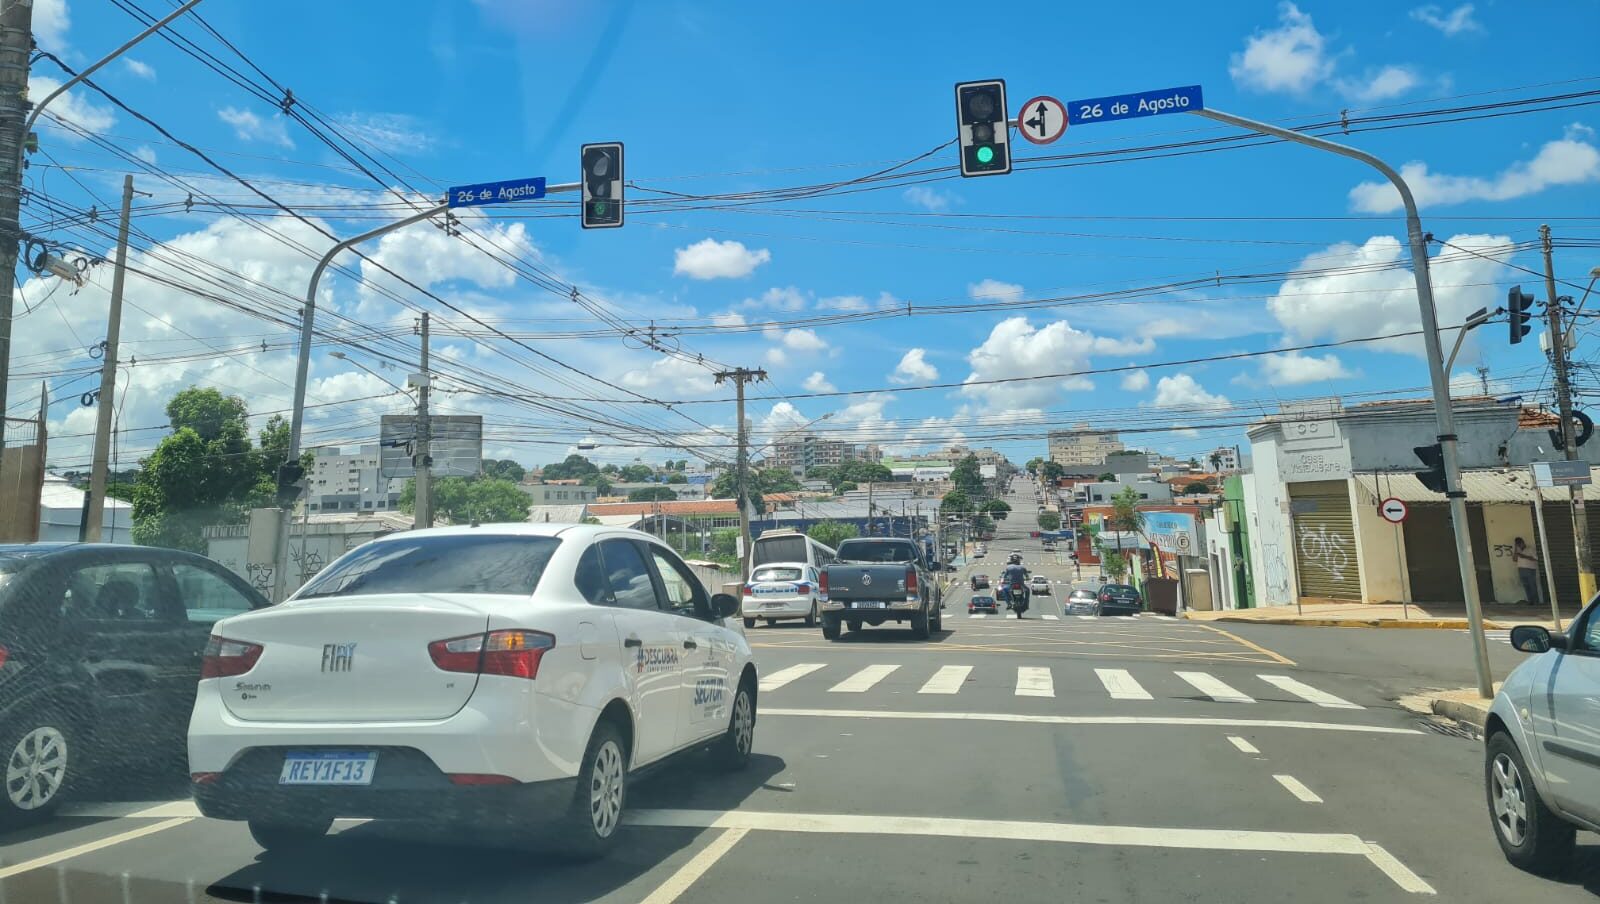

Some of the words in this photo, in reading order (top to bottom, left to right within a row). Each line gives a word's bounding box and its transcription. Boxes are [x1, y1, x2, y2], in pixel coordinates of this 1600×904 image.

[1080, 104, 1103, 119] 26
[1110, 102, 1129, 115] de
[1138, 94, 1190, 114] Agosto
[457, 190, 474, 202] 26
[480, 188, 492, 200] de
[498, 184, 536, 200] Agosto
[321, 643, 357, 673] FIAT
[637, 647, 679, 673] #DESCUBRA
[694, 678, 724, 706] SECTUR
[289, 760, 367, 781] REY1F13
